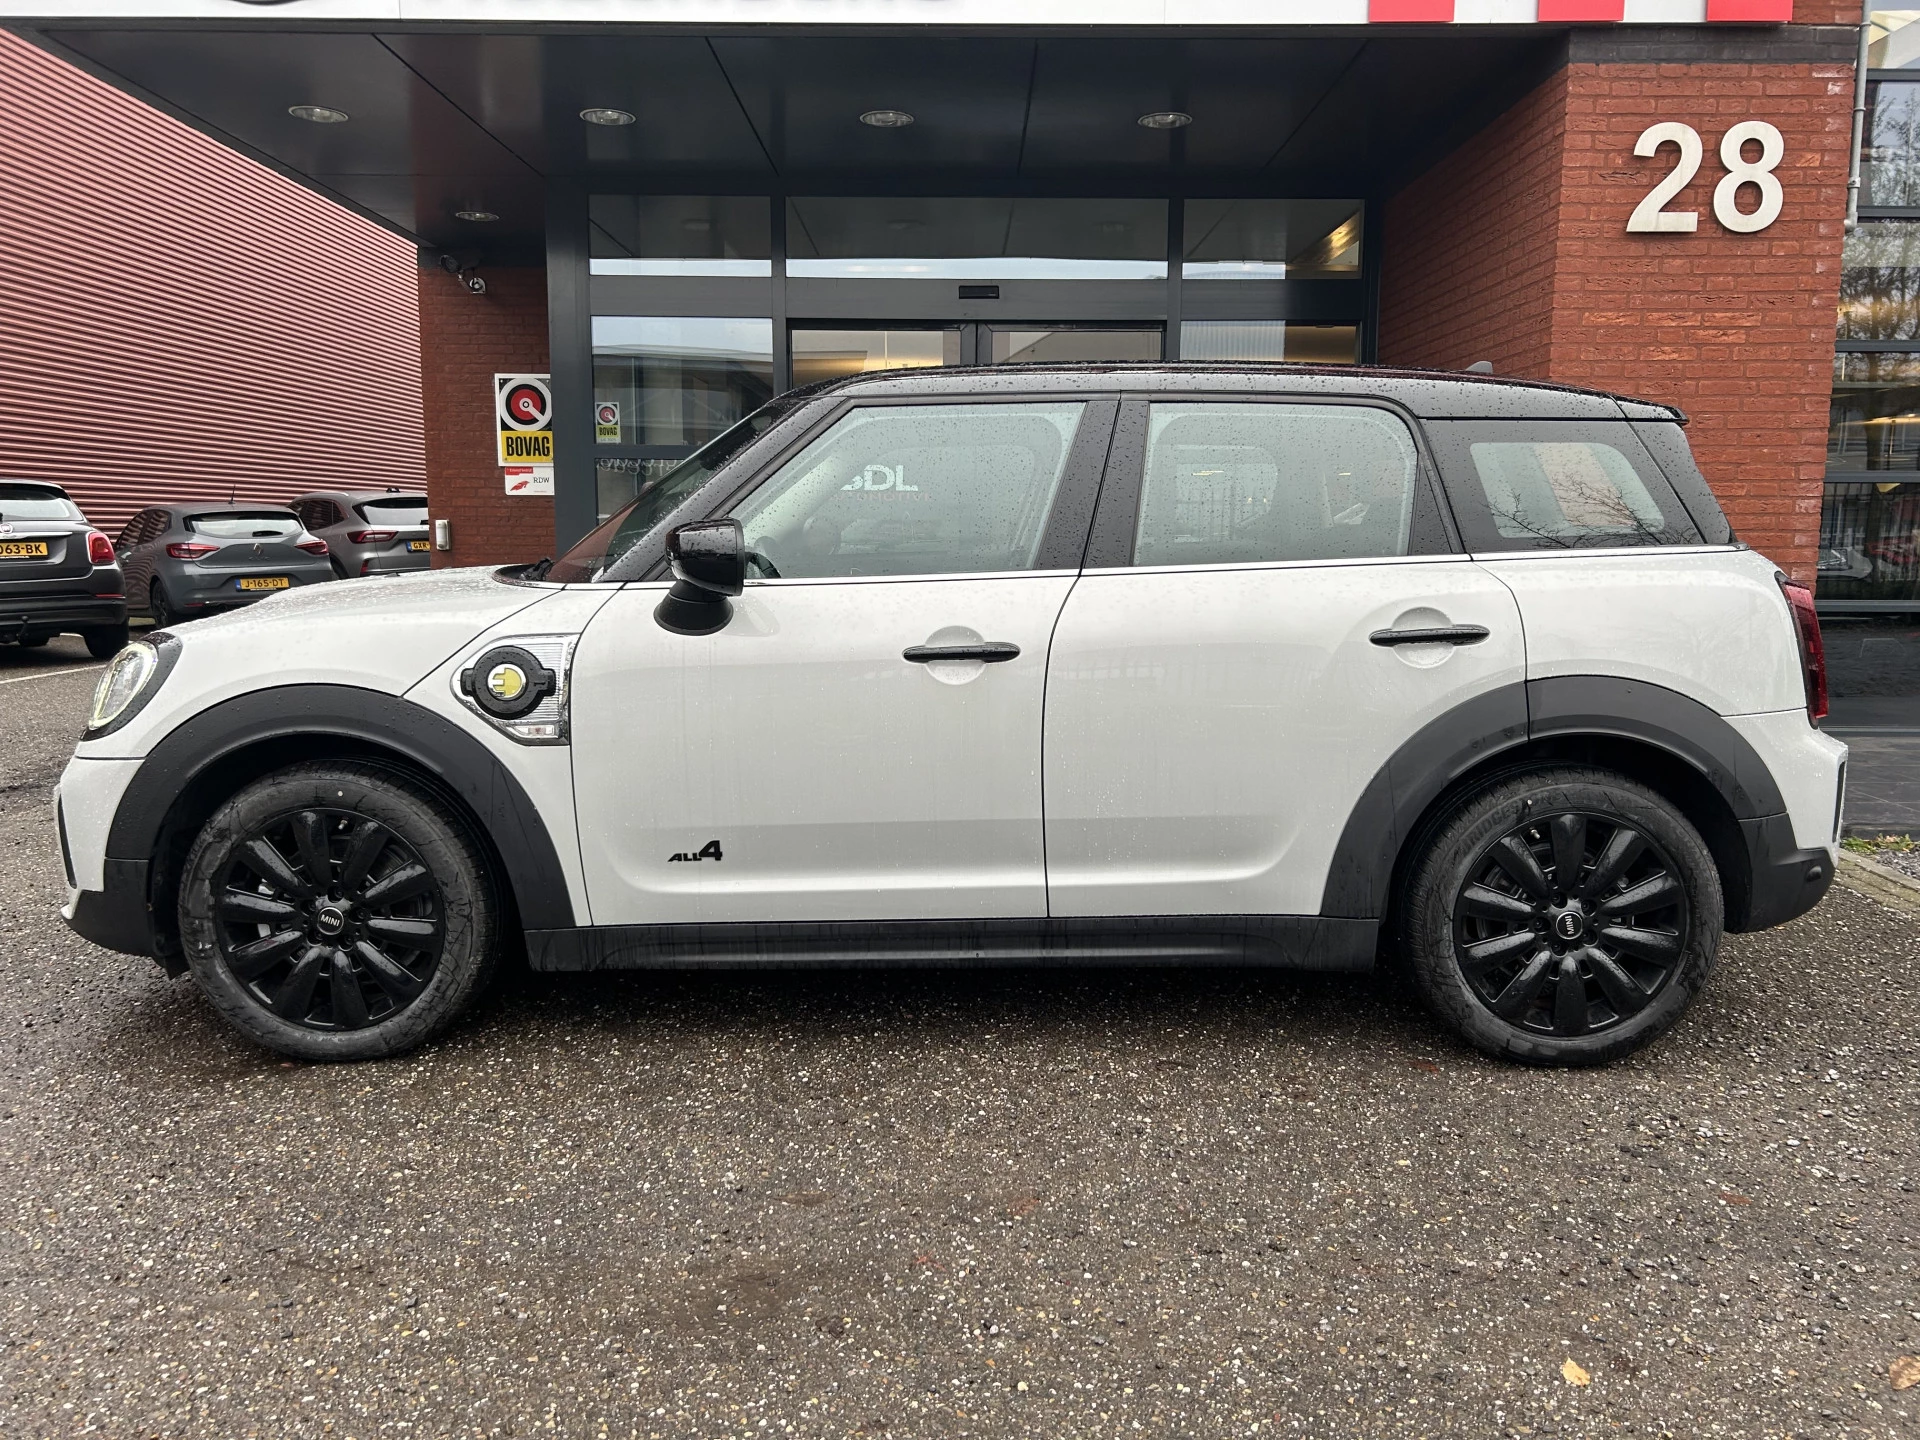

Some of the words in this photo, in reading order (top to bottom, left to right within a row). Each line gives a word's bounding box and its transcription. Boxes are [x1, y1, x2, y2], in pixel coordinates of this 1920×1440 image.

[1626, 120, 1785, 234] 28
[599, 427, 618, 436] BOVAG
[506, 436, 551, 457] BOVAG
[245, 578, 284, 588] J-165-DT
[320, 914, 340, 927] MINI
[1564, 915, 1575, 935] MINI
